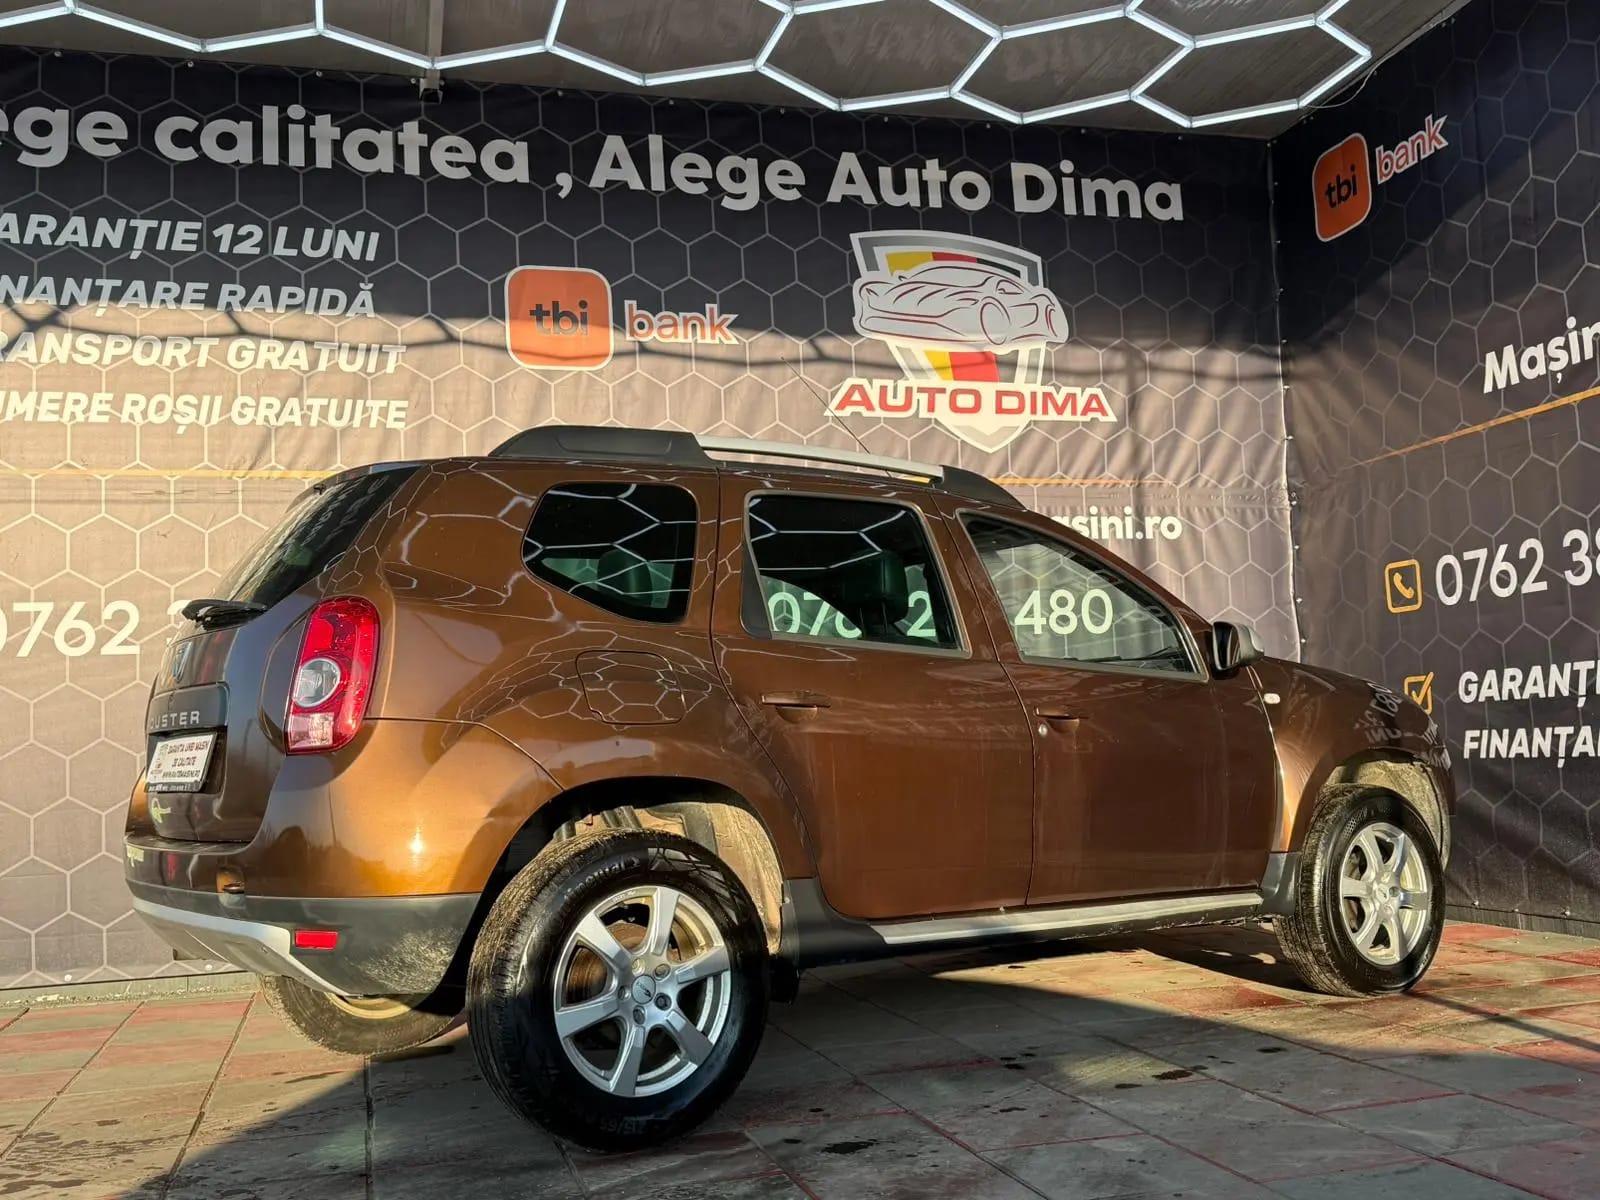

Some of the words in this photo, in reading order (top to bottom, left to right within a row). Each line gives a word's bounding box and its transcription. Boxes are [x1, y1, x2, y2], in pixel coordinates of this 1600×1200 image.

[0, 106, 128, 168] ge
[154, 105, 529, 184] calitatea
[588, 134, 805, 212] Alege
[827, 151, 992, 212] Auto
[1012, 159, 1184, 222] Dima
[1325, 164, 1357, 208] tbi
[1375, 114, 1447, 184] bank
[212, 224, 263, 255] 12
[272, 226, 380, 262] LUNI
[217, 282, 376, 318] RAPIDĂ
[530, 301, 588, 336] tbi
[625, 302, 737, 344] bank
[227, 338, 407, 375] GRATUIT
[120, 392, 223, 434] ROȘII
[231, 396, 409, 429] GRATUITE
[835, 384, 981, 414] AUTO
[994, 390, 1108, 417] DIMA
[1435, 537, 1548, 606] 0762
[0, 600, 141, 658] 762
[1014, 589, 1114, 635] 480
